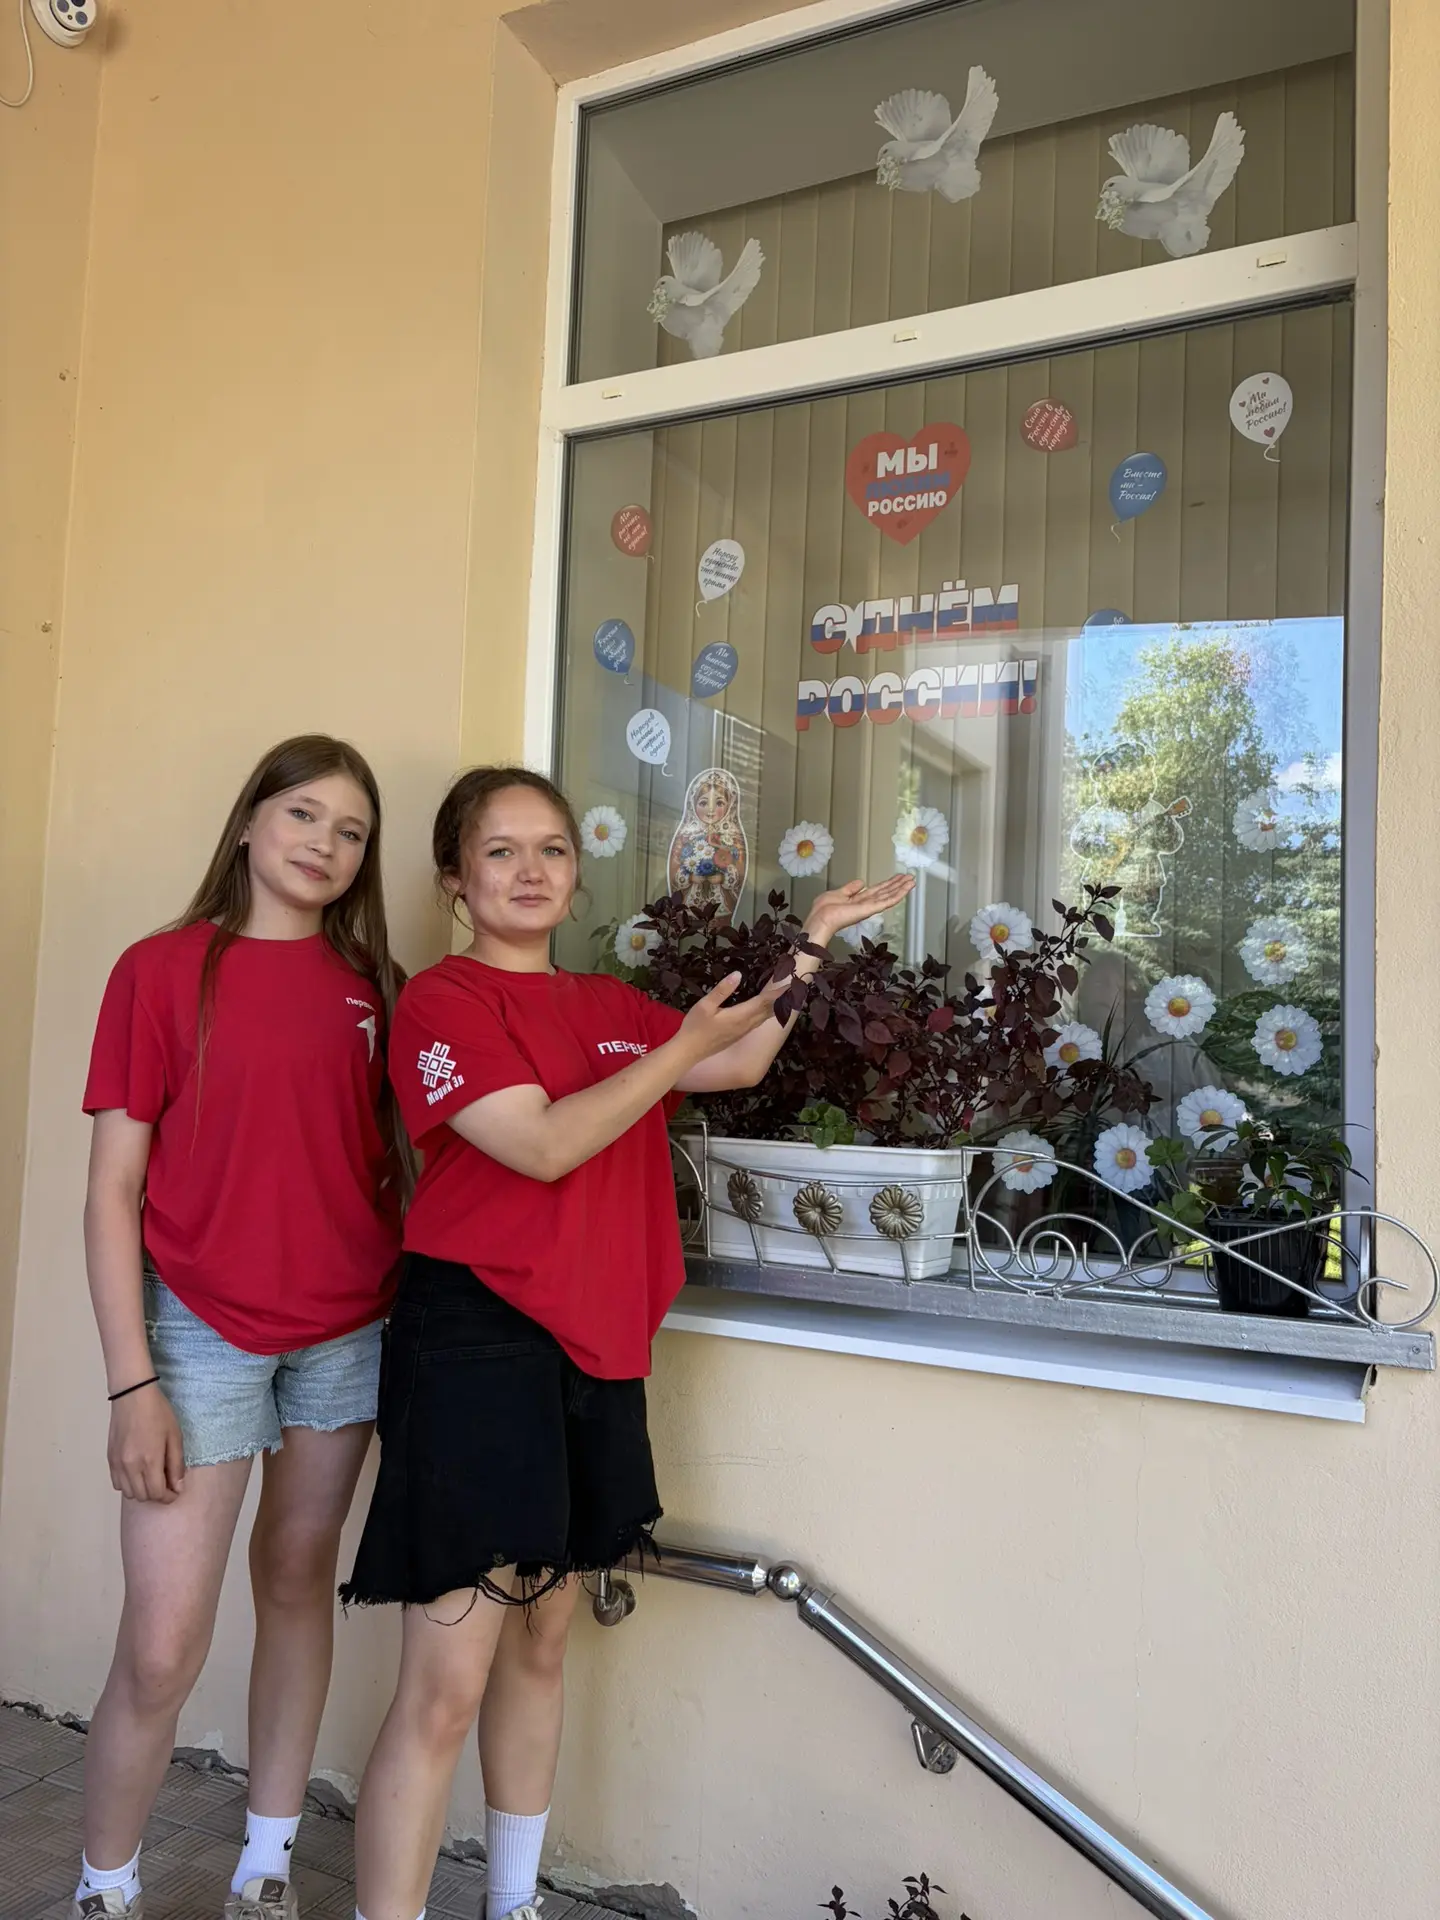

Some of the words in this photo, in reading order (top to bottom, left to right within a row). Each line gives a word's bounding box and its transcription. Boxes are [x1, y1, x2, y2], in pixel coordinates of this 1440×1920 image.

[1245, 397, 1280, 418] любим
[1250, 391, 1267, 404] Мы
[1025, 407, 1041, 428] Сила
[1028, 411, 1049, 442] России
[1039, 405, 1065, 446] единстве
[1048, 409, 1072, 450] народов!
[1245, 401, 1288, 430] Россию!
[876, 442, 939, 479] МЫ
[1123, 468, 1162, 479] Вместе
[864, 470, 952, 500] ЛЮБИМ
[1118, 490, 1157, 501] Россия!
[867, 490, 948, 517] РОССИЮ
[810, 603, 847, 655] С
[855, 579, 1019, 655] ДНЁМ
[796, 659, 1039, 732] РОССИИ!
[426, 1080, 454, 1107] Марий
[451, 1074, 465, 1089] Эл
